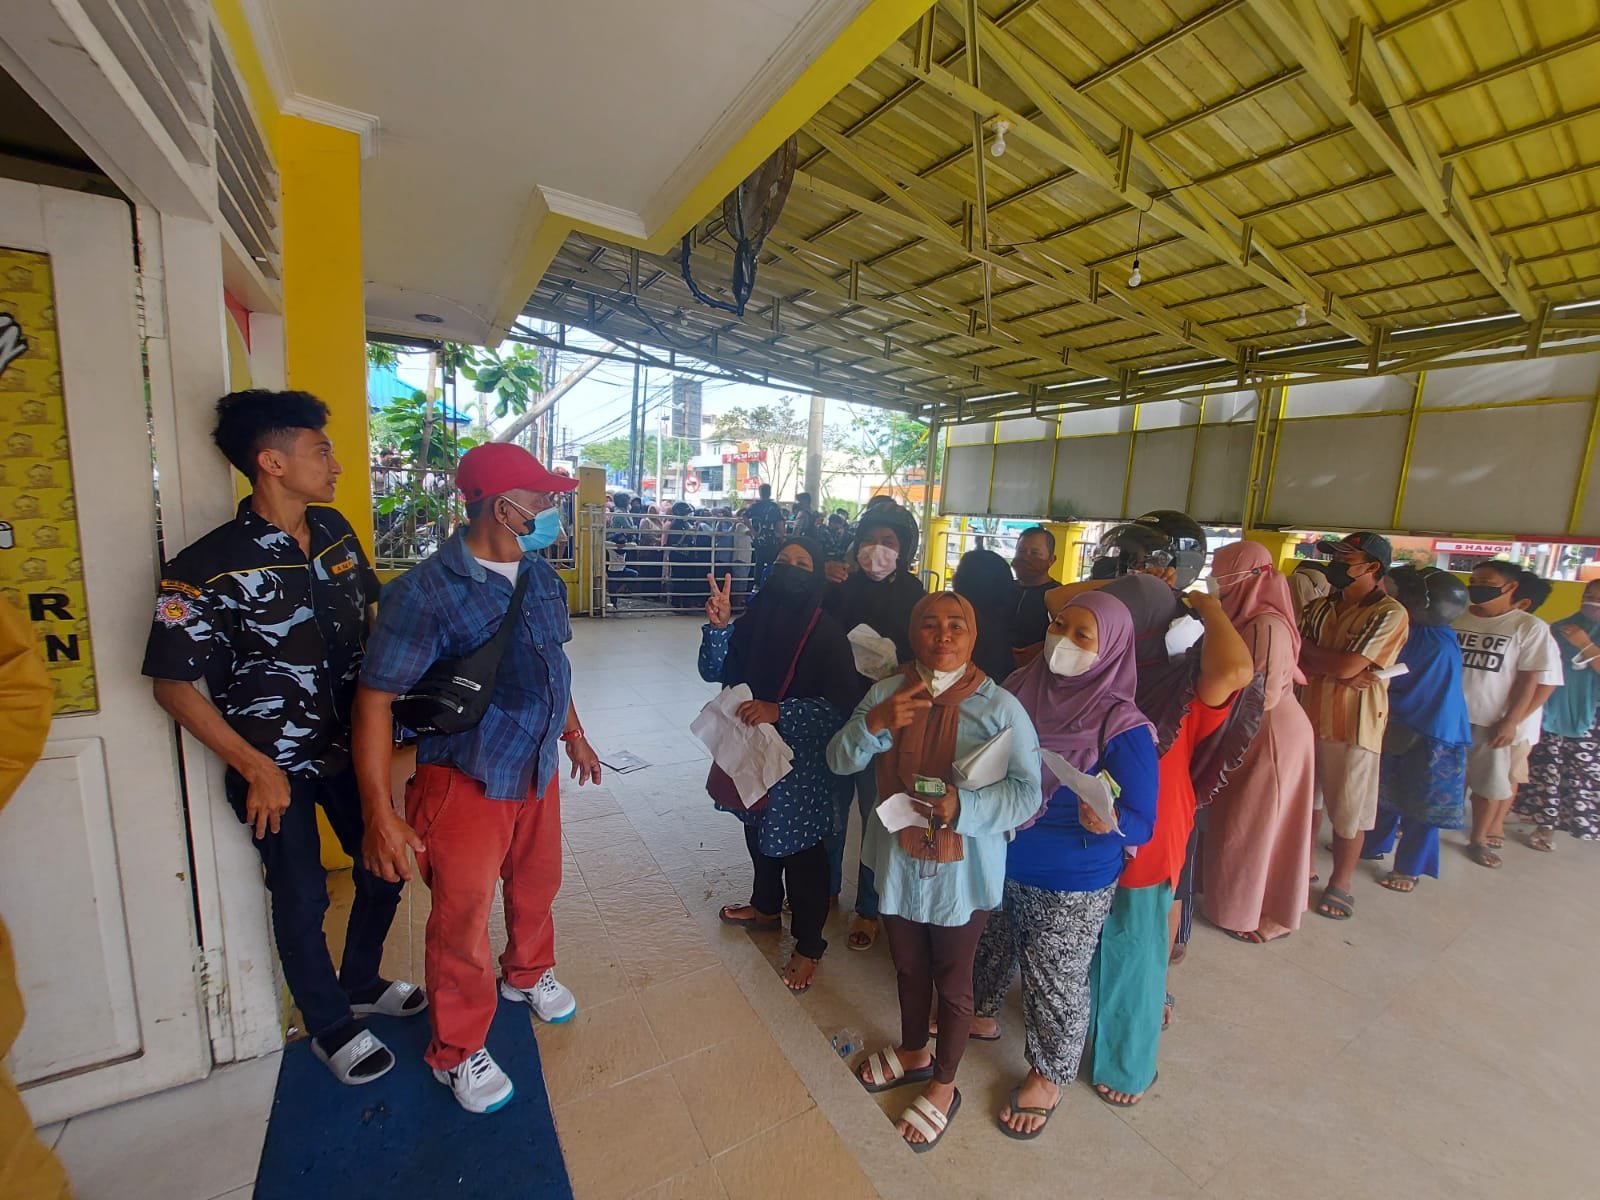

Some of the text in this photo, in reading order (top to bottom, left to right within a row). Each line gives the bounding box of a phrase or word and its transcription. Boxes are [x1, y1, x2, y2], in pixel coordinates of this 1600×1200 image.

[1455, 544, 1522, 553] SHANGH
[1456, 633, 1506, 650] NE OF
